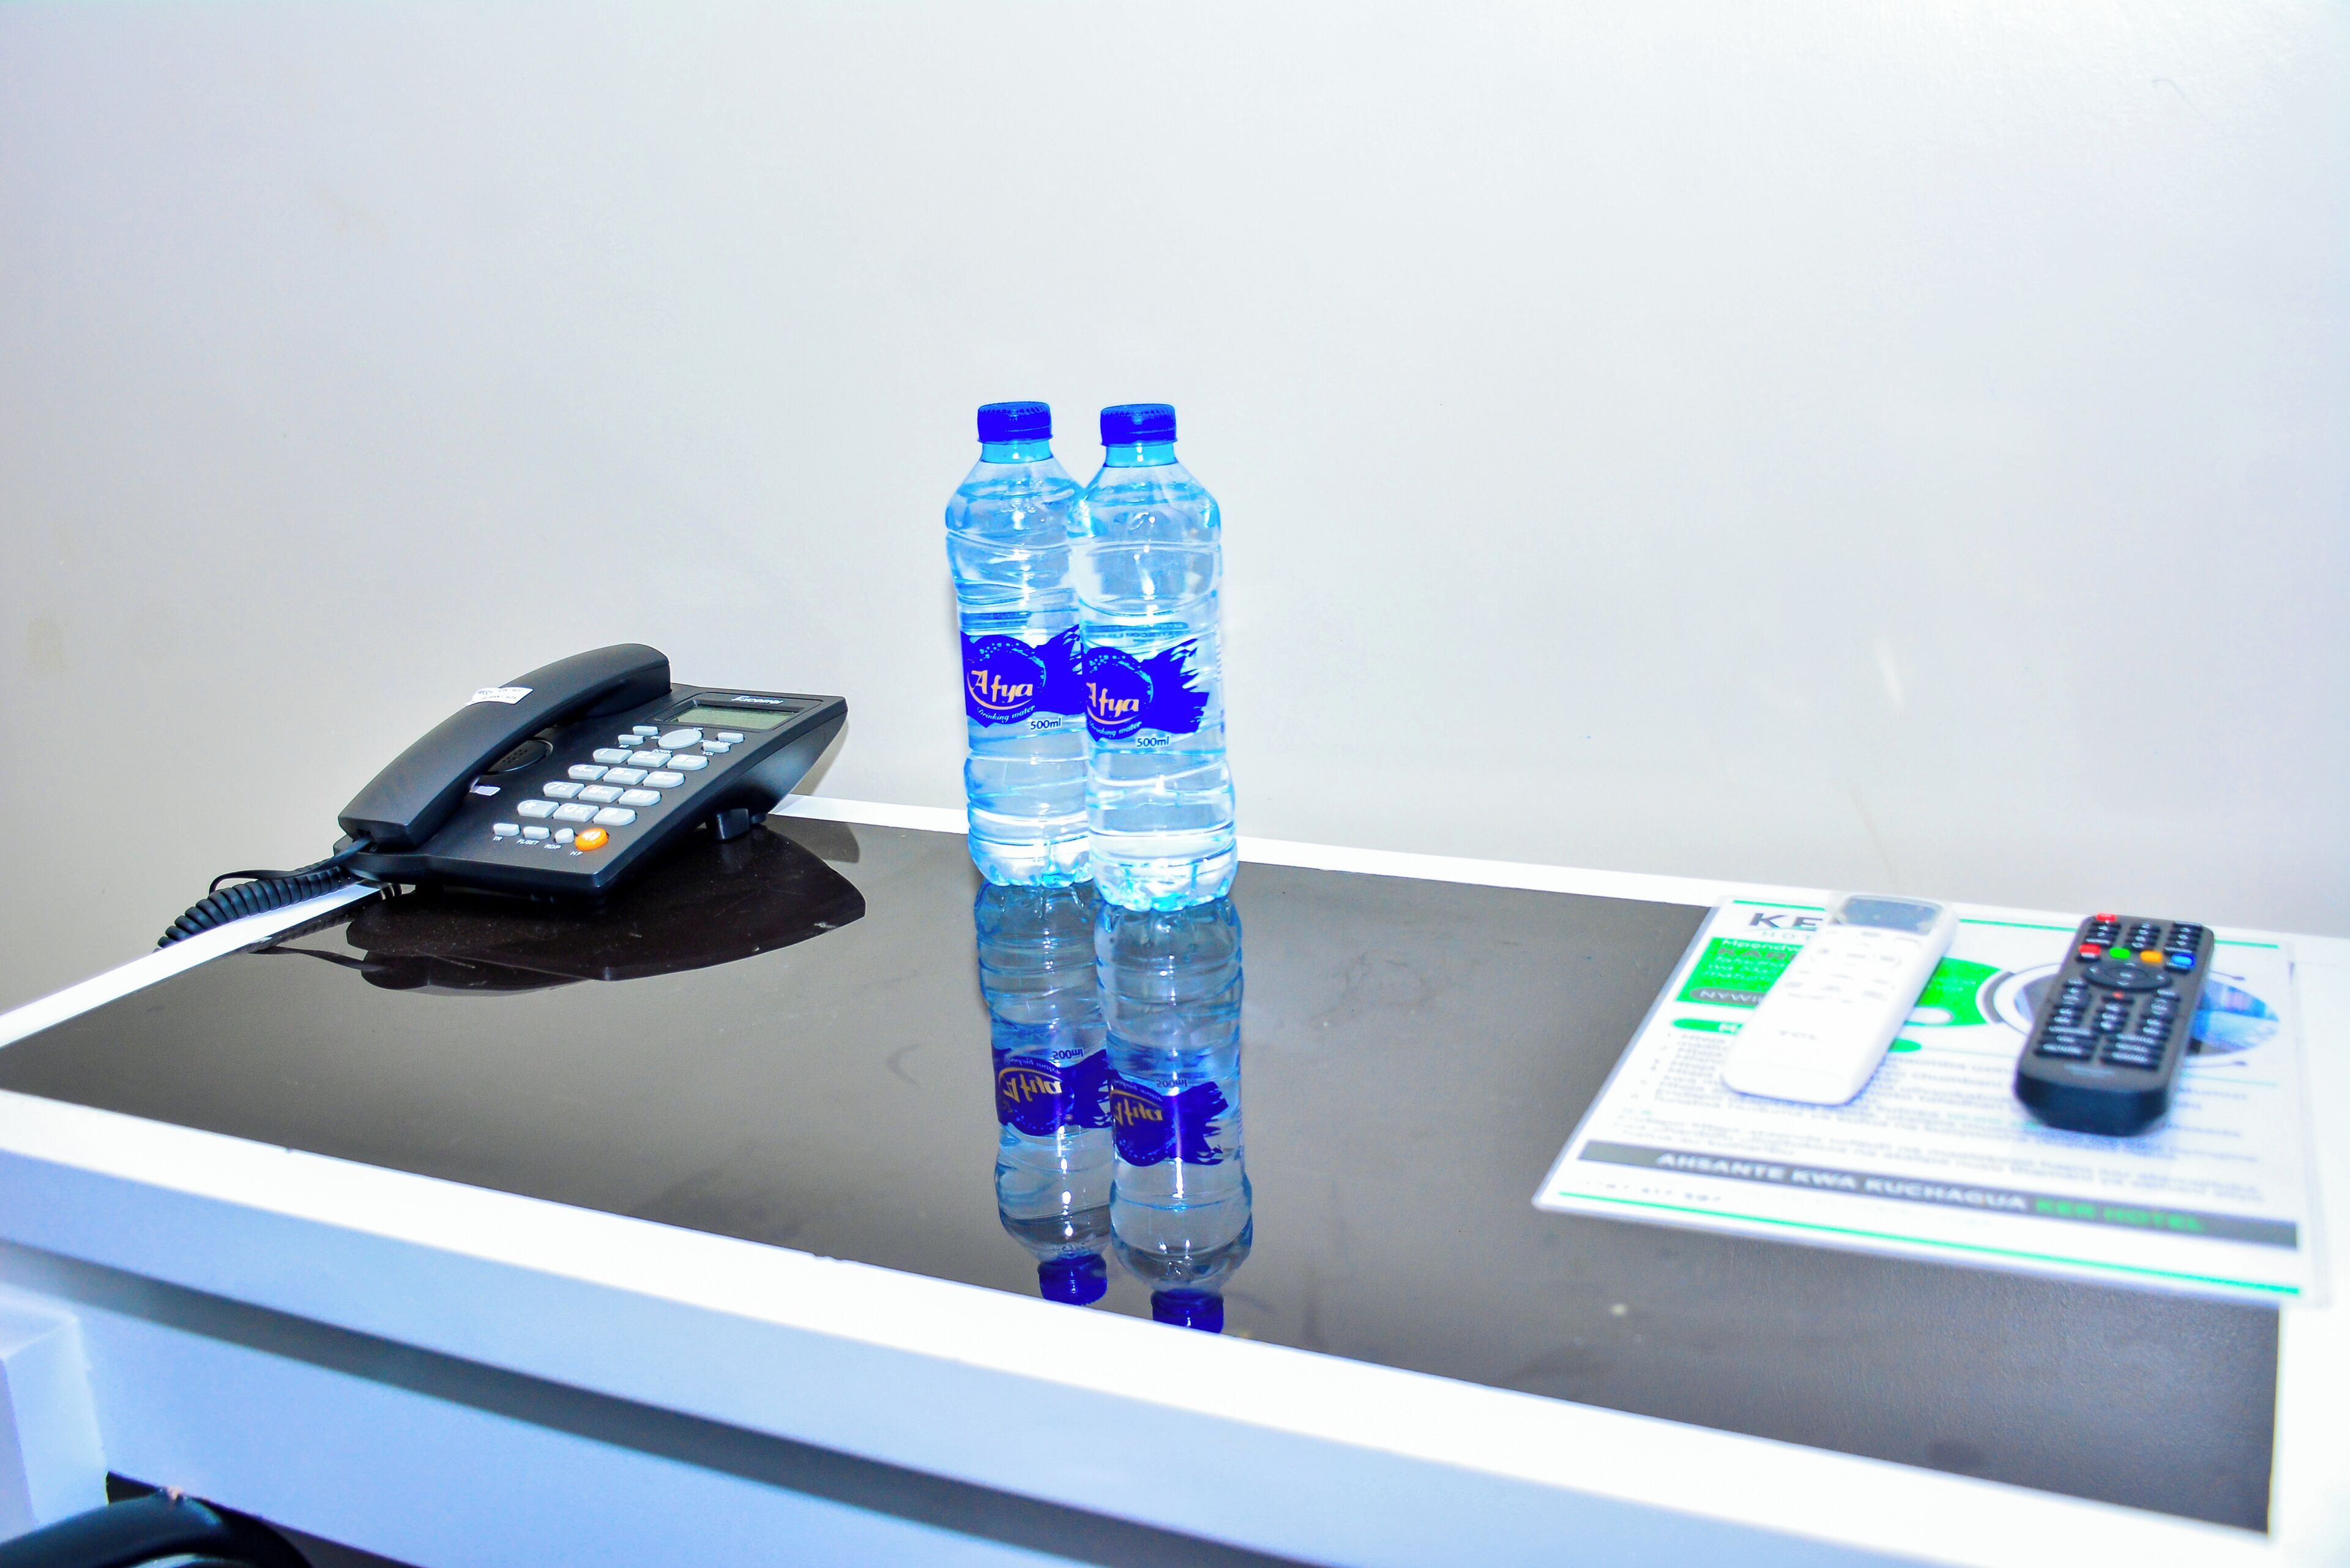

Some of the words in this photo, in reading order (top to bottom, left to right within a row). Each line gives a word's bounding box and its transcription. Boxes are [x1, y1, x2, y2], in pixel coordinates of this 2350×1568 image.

[971, 670, 1033, 703] Afya
[977, 707, 1009, 723] Drinking
[1012, 705, 1035, 719] water
[1030, 718, 1061, 730] 500ml
[1136, 736, 1170, 747] 500ml
[1656, 1152, 1786, 1181] AHSANTE
[1791, 1168, 1857, 1190] KWA
[1863, 1176, 2028, 1211] KUCHAGUA
[2102, 1206, 2205, 1231] HOTEL
